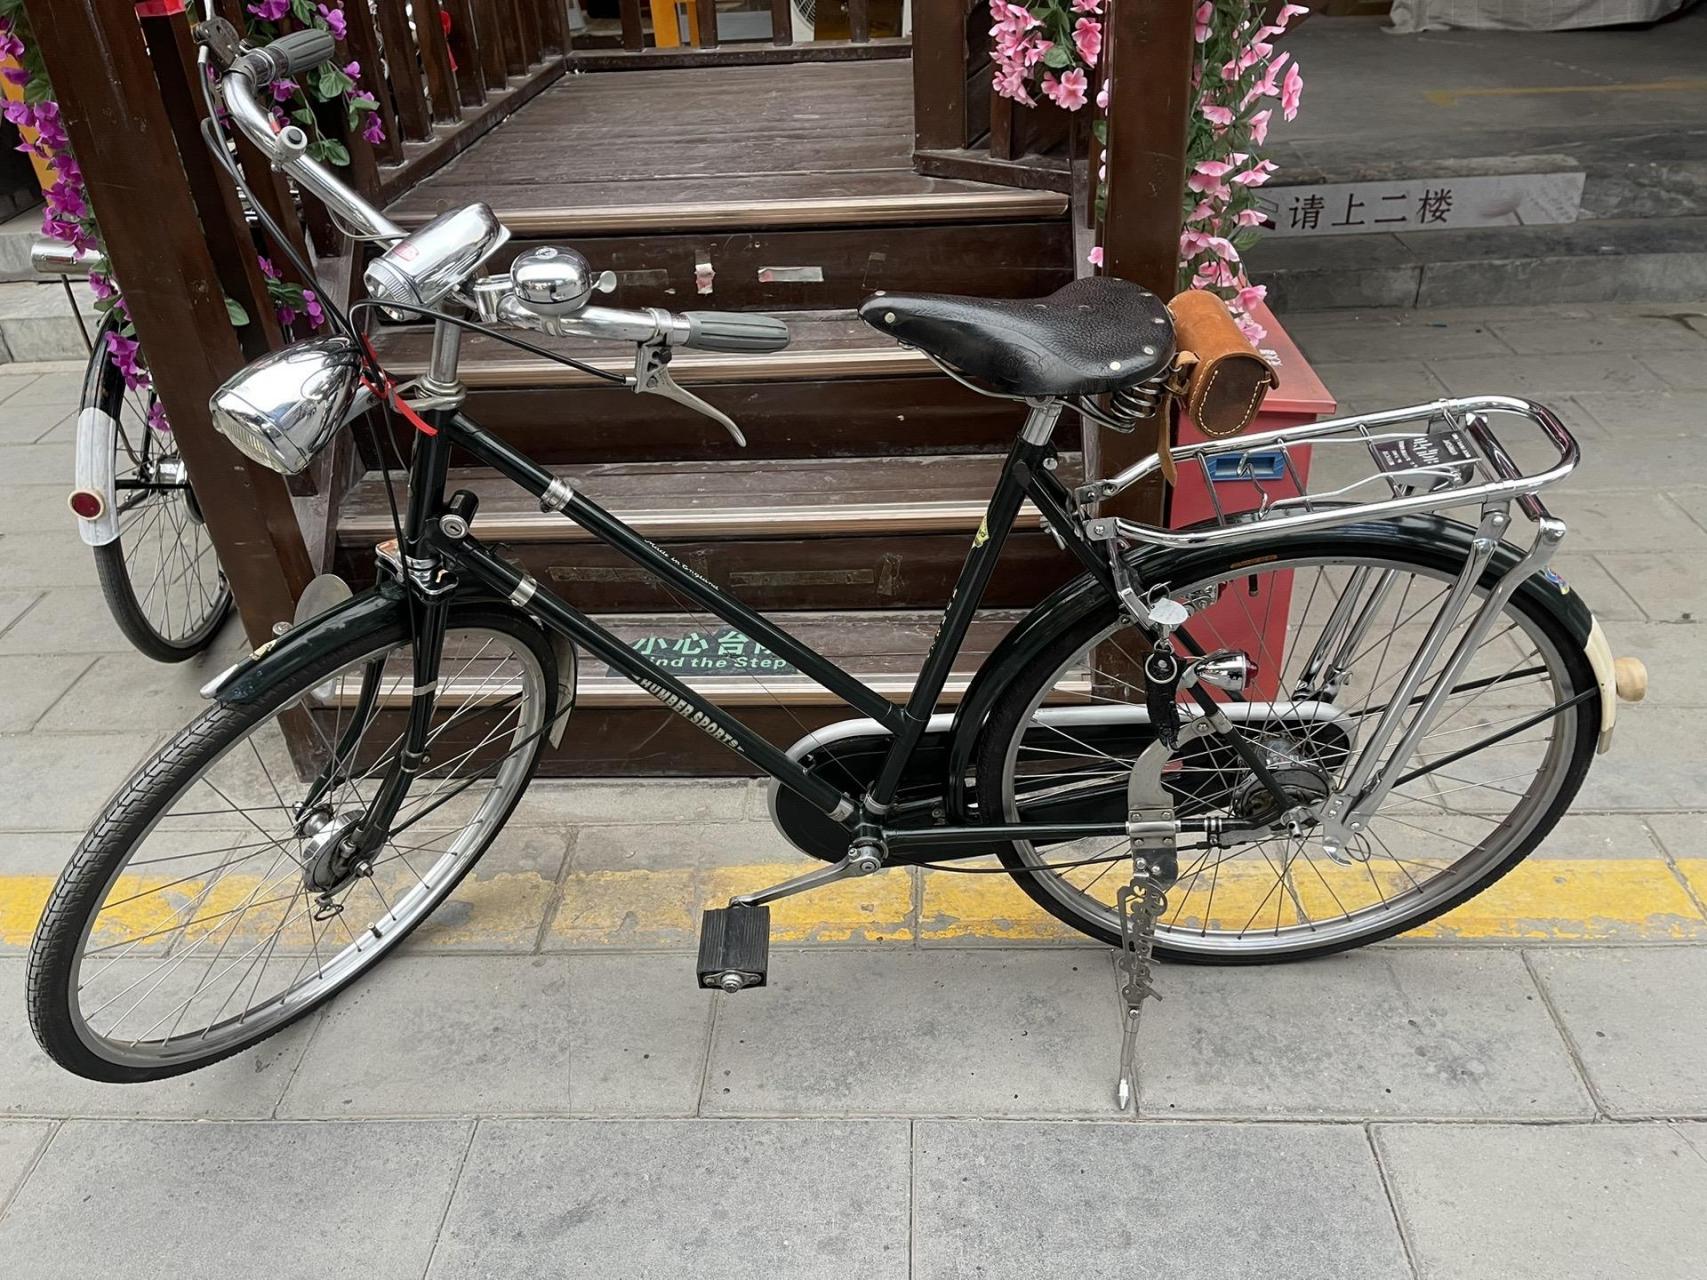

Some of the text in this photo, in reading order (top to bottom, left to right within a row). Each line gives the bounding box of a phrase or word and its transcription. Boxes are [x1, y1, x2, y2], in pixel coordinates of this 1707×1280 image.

[1288, 188, 1453, 230] 请上二楼
[650, 656, 787, 670] ind the Step
[640, 678, 739, 749] HUMBER SPORTS
